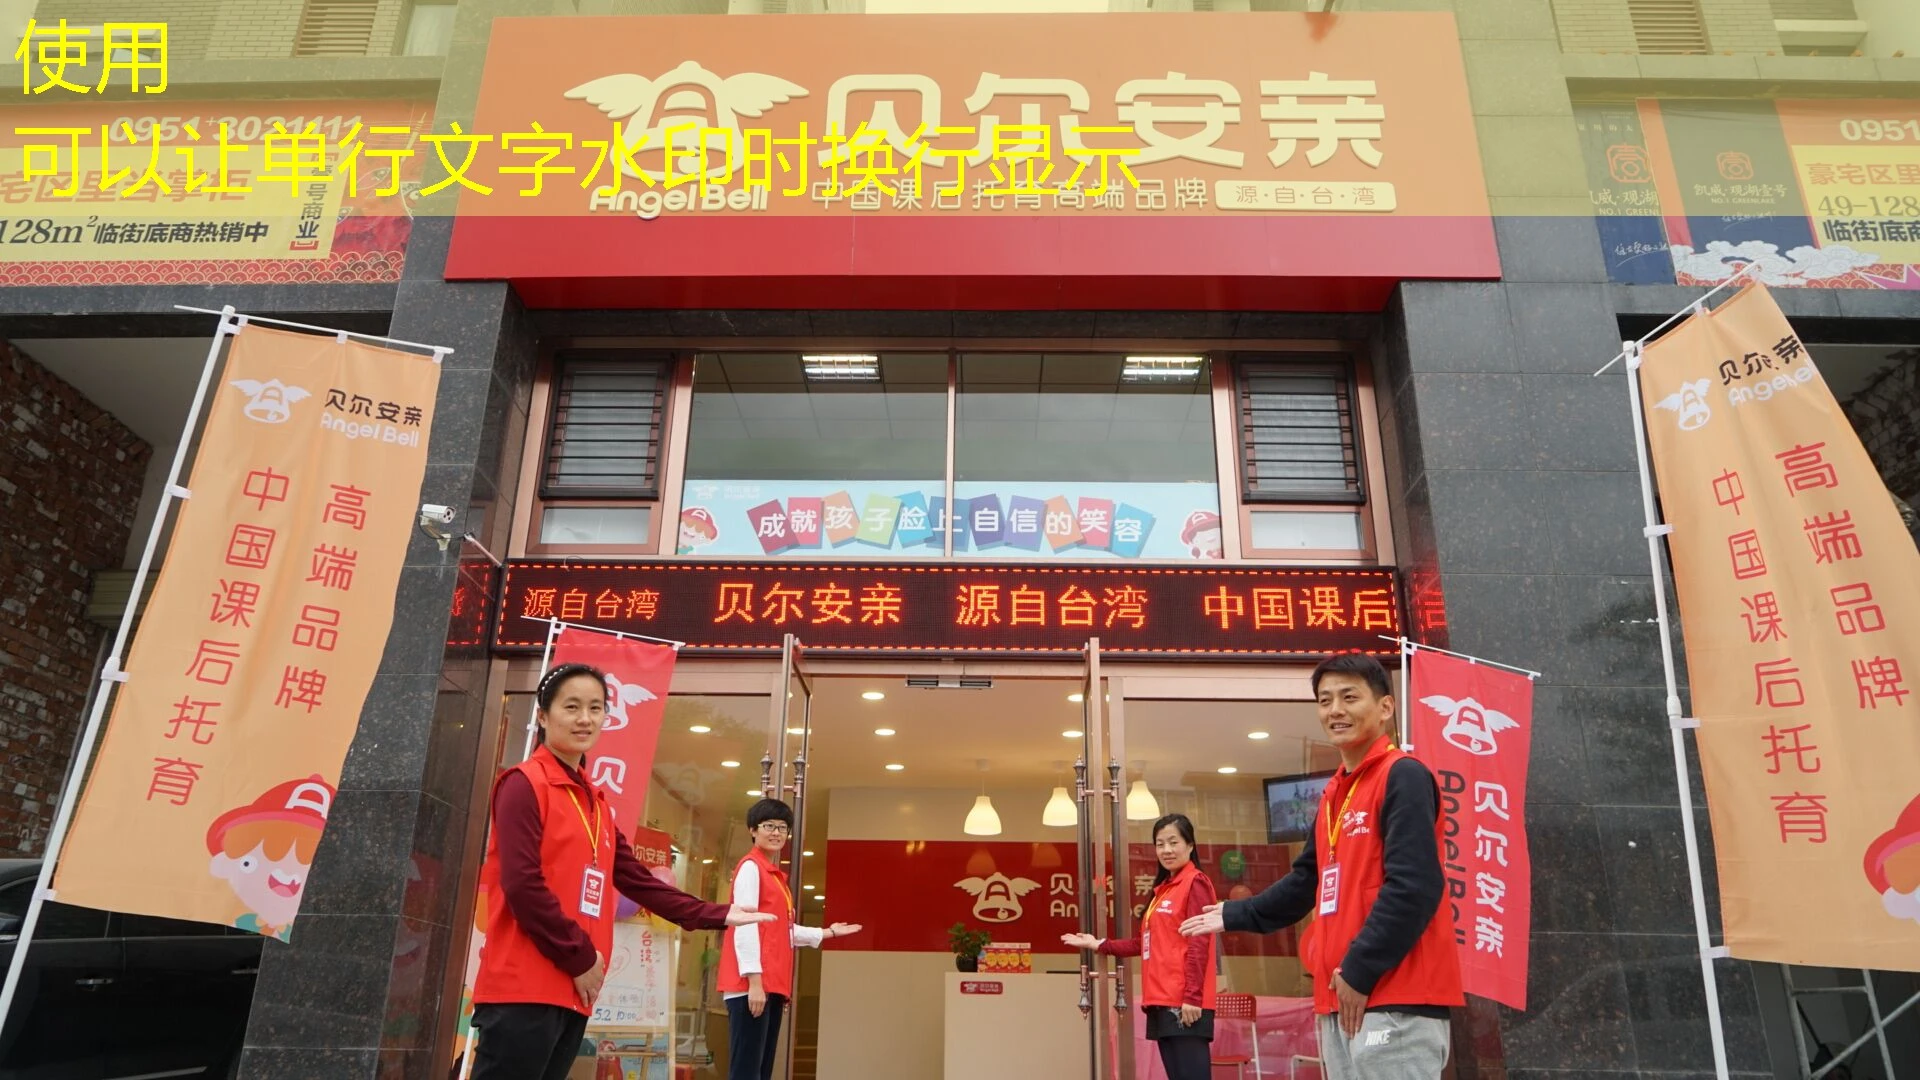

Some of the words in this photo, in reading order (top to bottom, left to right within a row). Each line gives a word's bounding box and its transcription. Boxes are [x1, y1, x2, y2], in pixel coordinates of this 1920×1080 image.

[817, 71, 1386, 169] 贝尔安亲
[588, 184, 697, 219] Angel
[701, 185, 768, 211] Bell
[811, 177, 1209, 211] 中国课后托育高端品牌
[1719, 334, 1804, 386] 贝尔亲
[320, 411, 381, 440] Angel
[382, 425, 420, 448] Bell
[324, 388, 423, 428] 贝尔安亲
[757, 503, 1143, 542] 成就孩子脸上自信的笑容
[274, 484, 371, 714] 高端品牌
[1774, 440, 1910, 710] 高端品牌
[524, 587, 661, 620] 源自台湾
[713, 582, 902, 627] 贝尔安亲
[955, 584, 1148, 629] 源自台湾
[1203, 585, 1392, 631] 中国课后
[146, 466, 290, 807] 中国课后托育
[1711, 467, 1829, 844] 中国课后托育
[631, 844, 667, 866] 尔安亲
[1474, 780, 1511, 959] 贝尔安亲
[1365, 1029, 1391, 1046] NIKE
